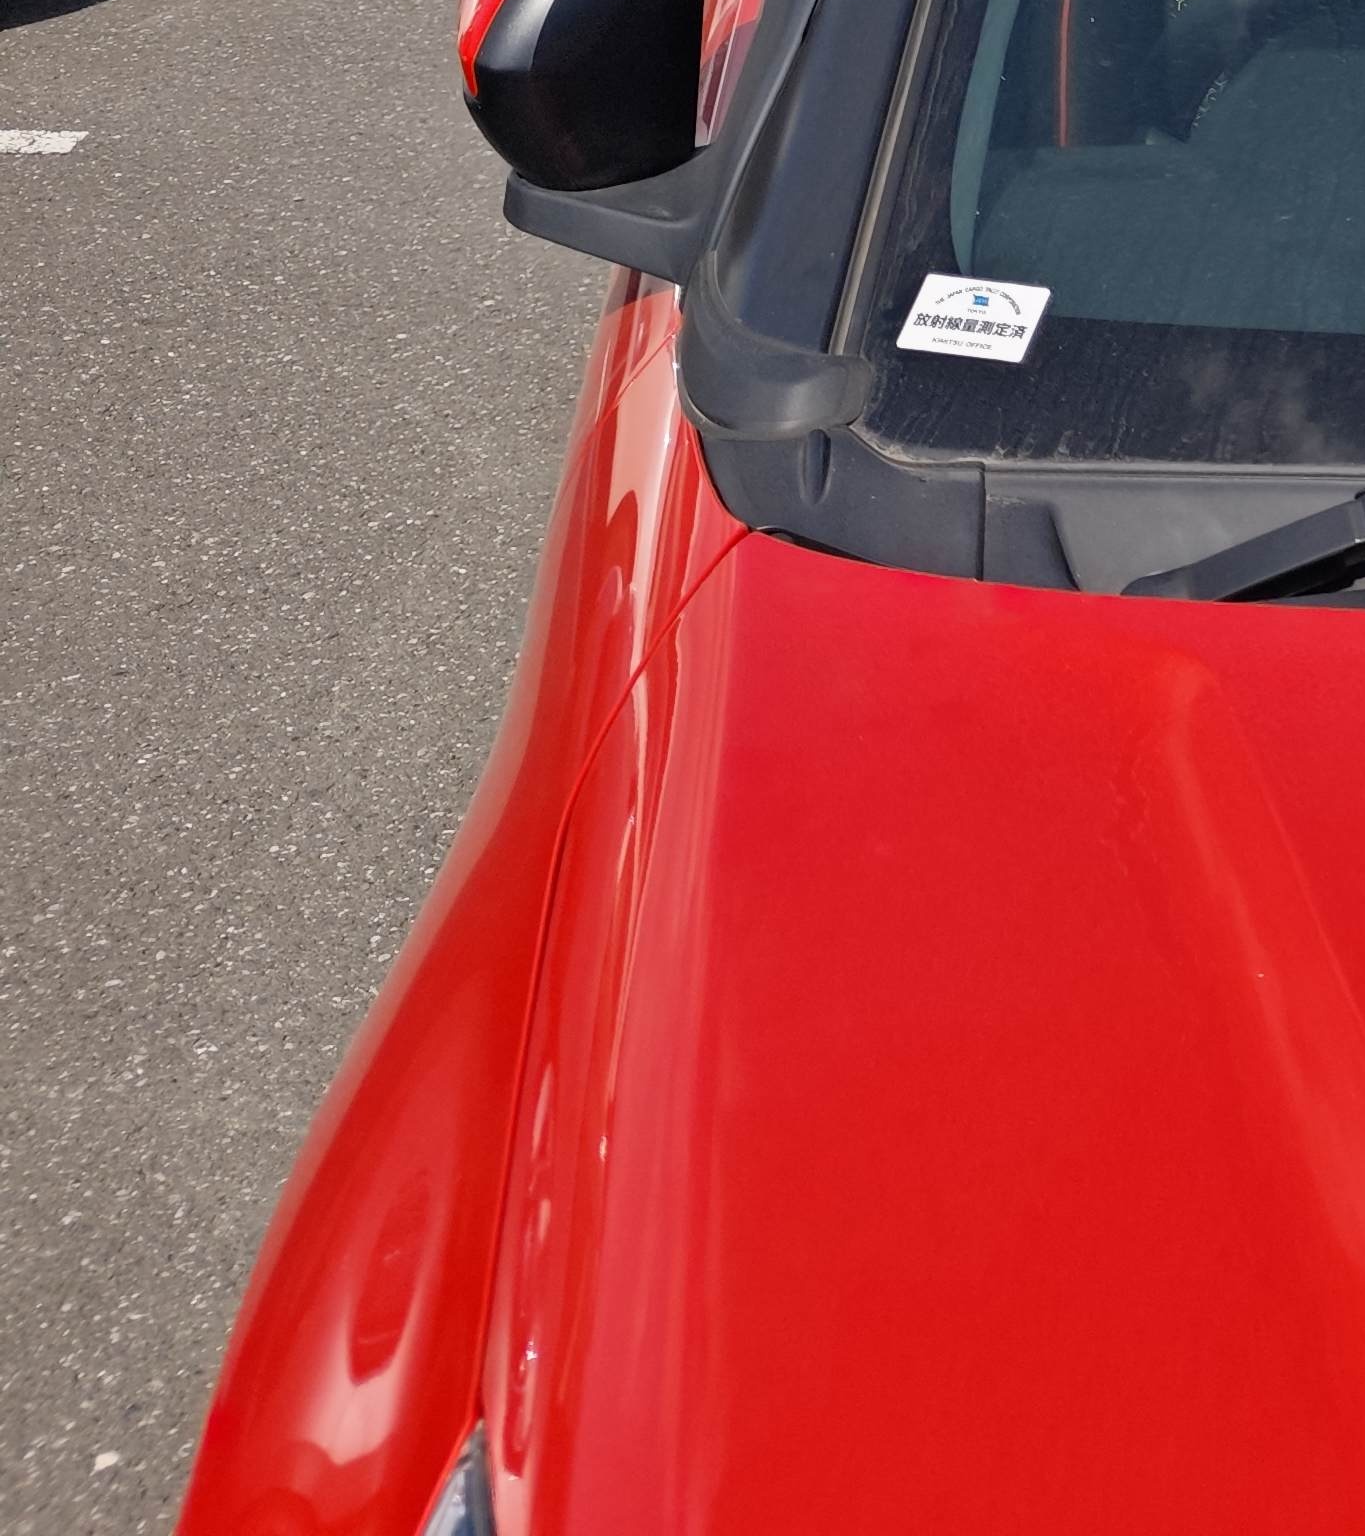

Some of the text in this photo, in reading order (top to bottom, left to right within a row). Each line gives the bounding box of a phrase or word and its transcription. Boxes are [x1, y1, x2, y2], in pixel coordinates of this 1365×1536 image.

[913, 312, 1029, 340] 放射線量測定済
